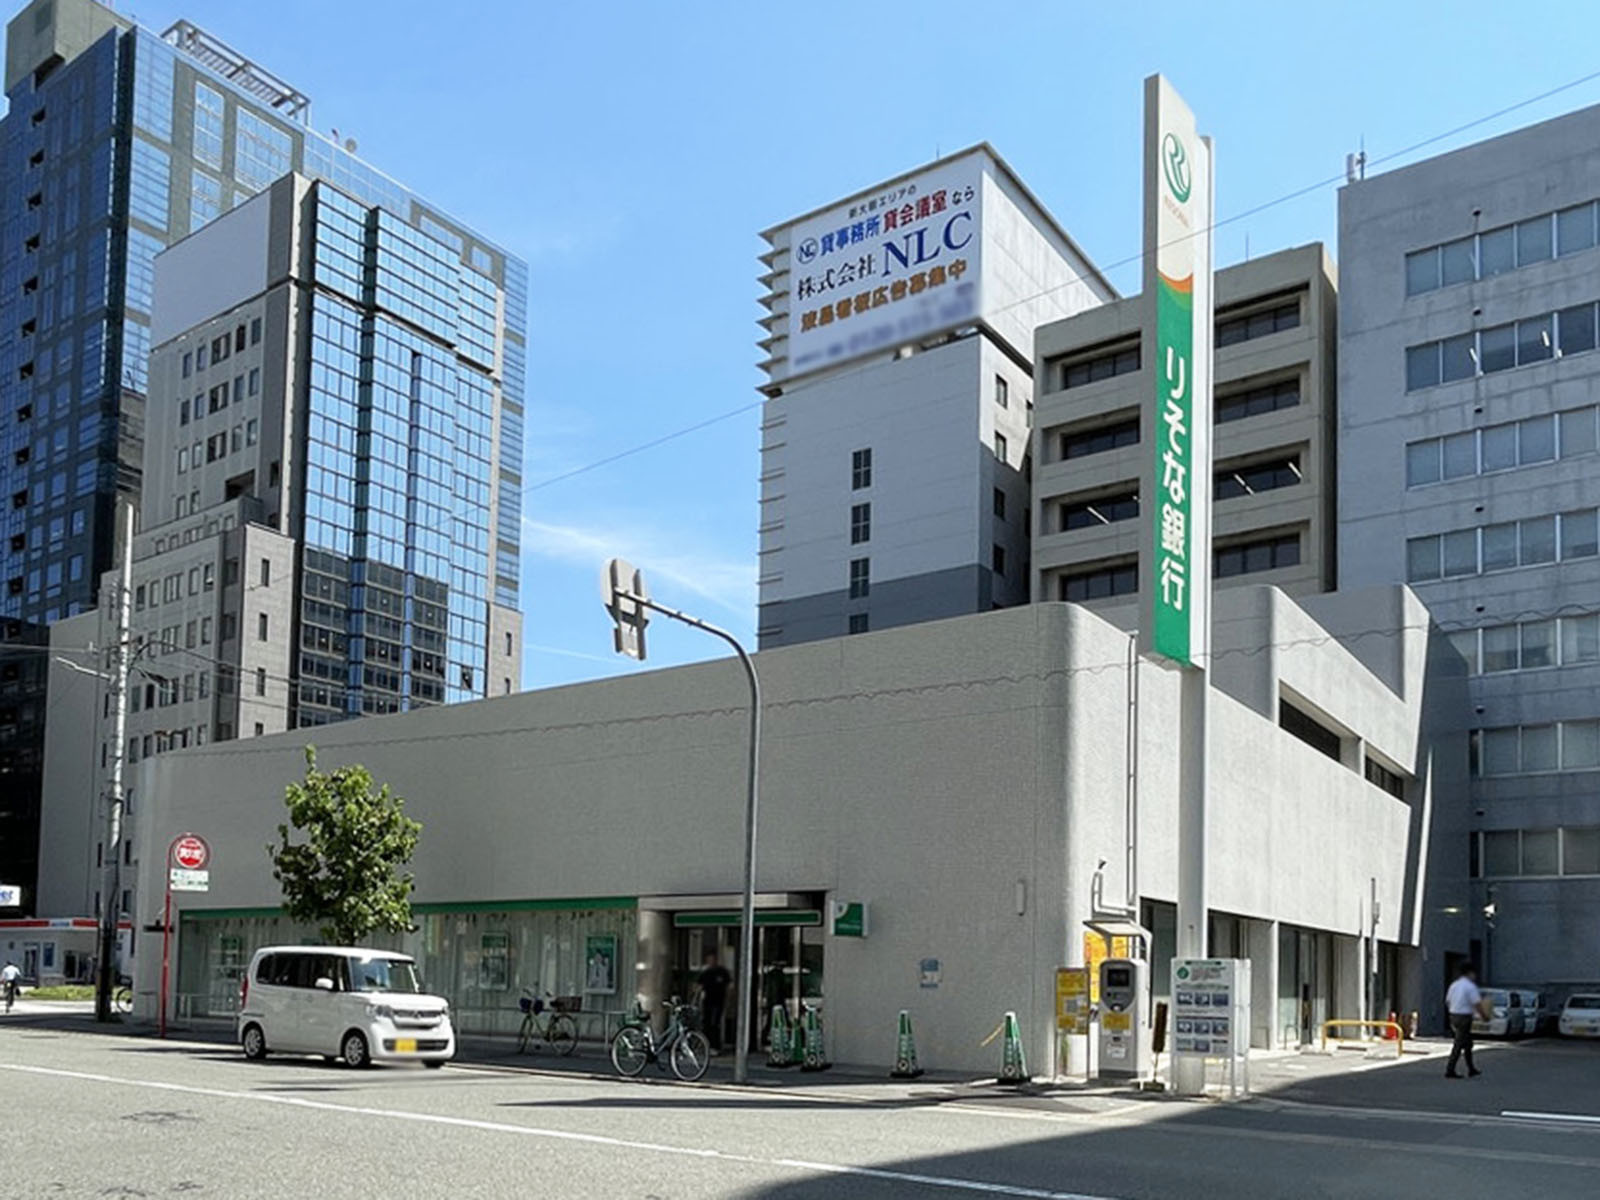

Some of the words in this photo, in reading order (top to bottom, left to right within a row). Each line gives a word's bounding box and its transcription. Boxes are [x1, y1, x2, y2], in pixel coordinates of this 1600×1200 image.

[797, 253, 877, 300] 株式会社
[881, 211, 973, 277] NLC
[821, 215, 880, 256] 貸事務所
[883, 189, 947, 233] 貸会議室
[952, 186, 975, 206] なら
[1161, 345, 1186, 612] りそな銀行
